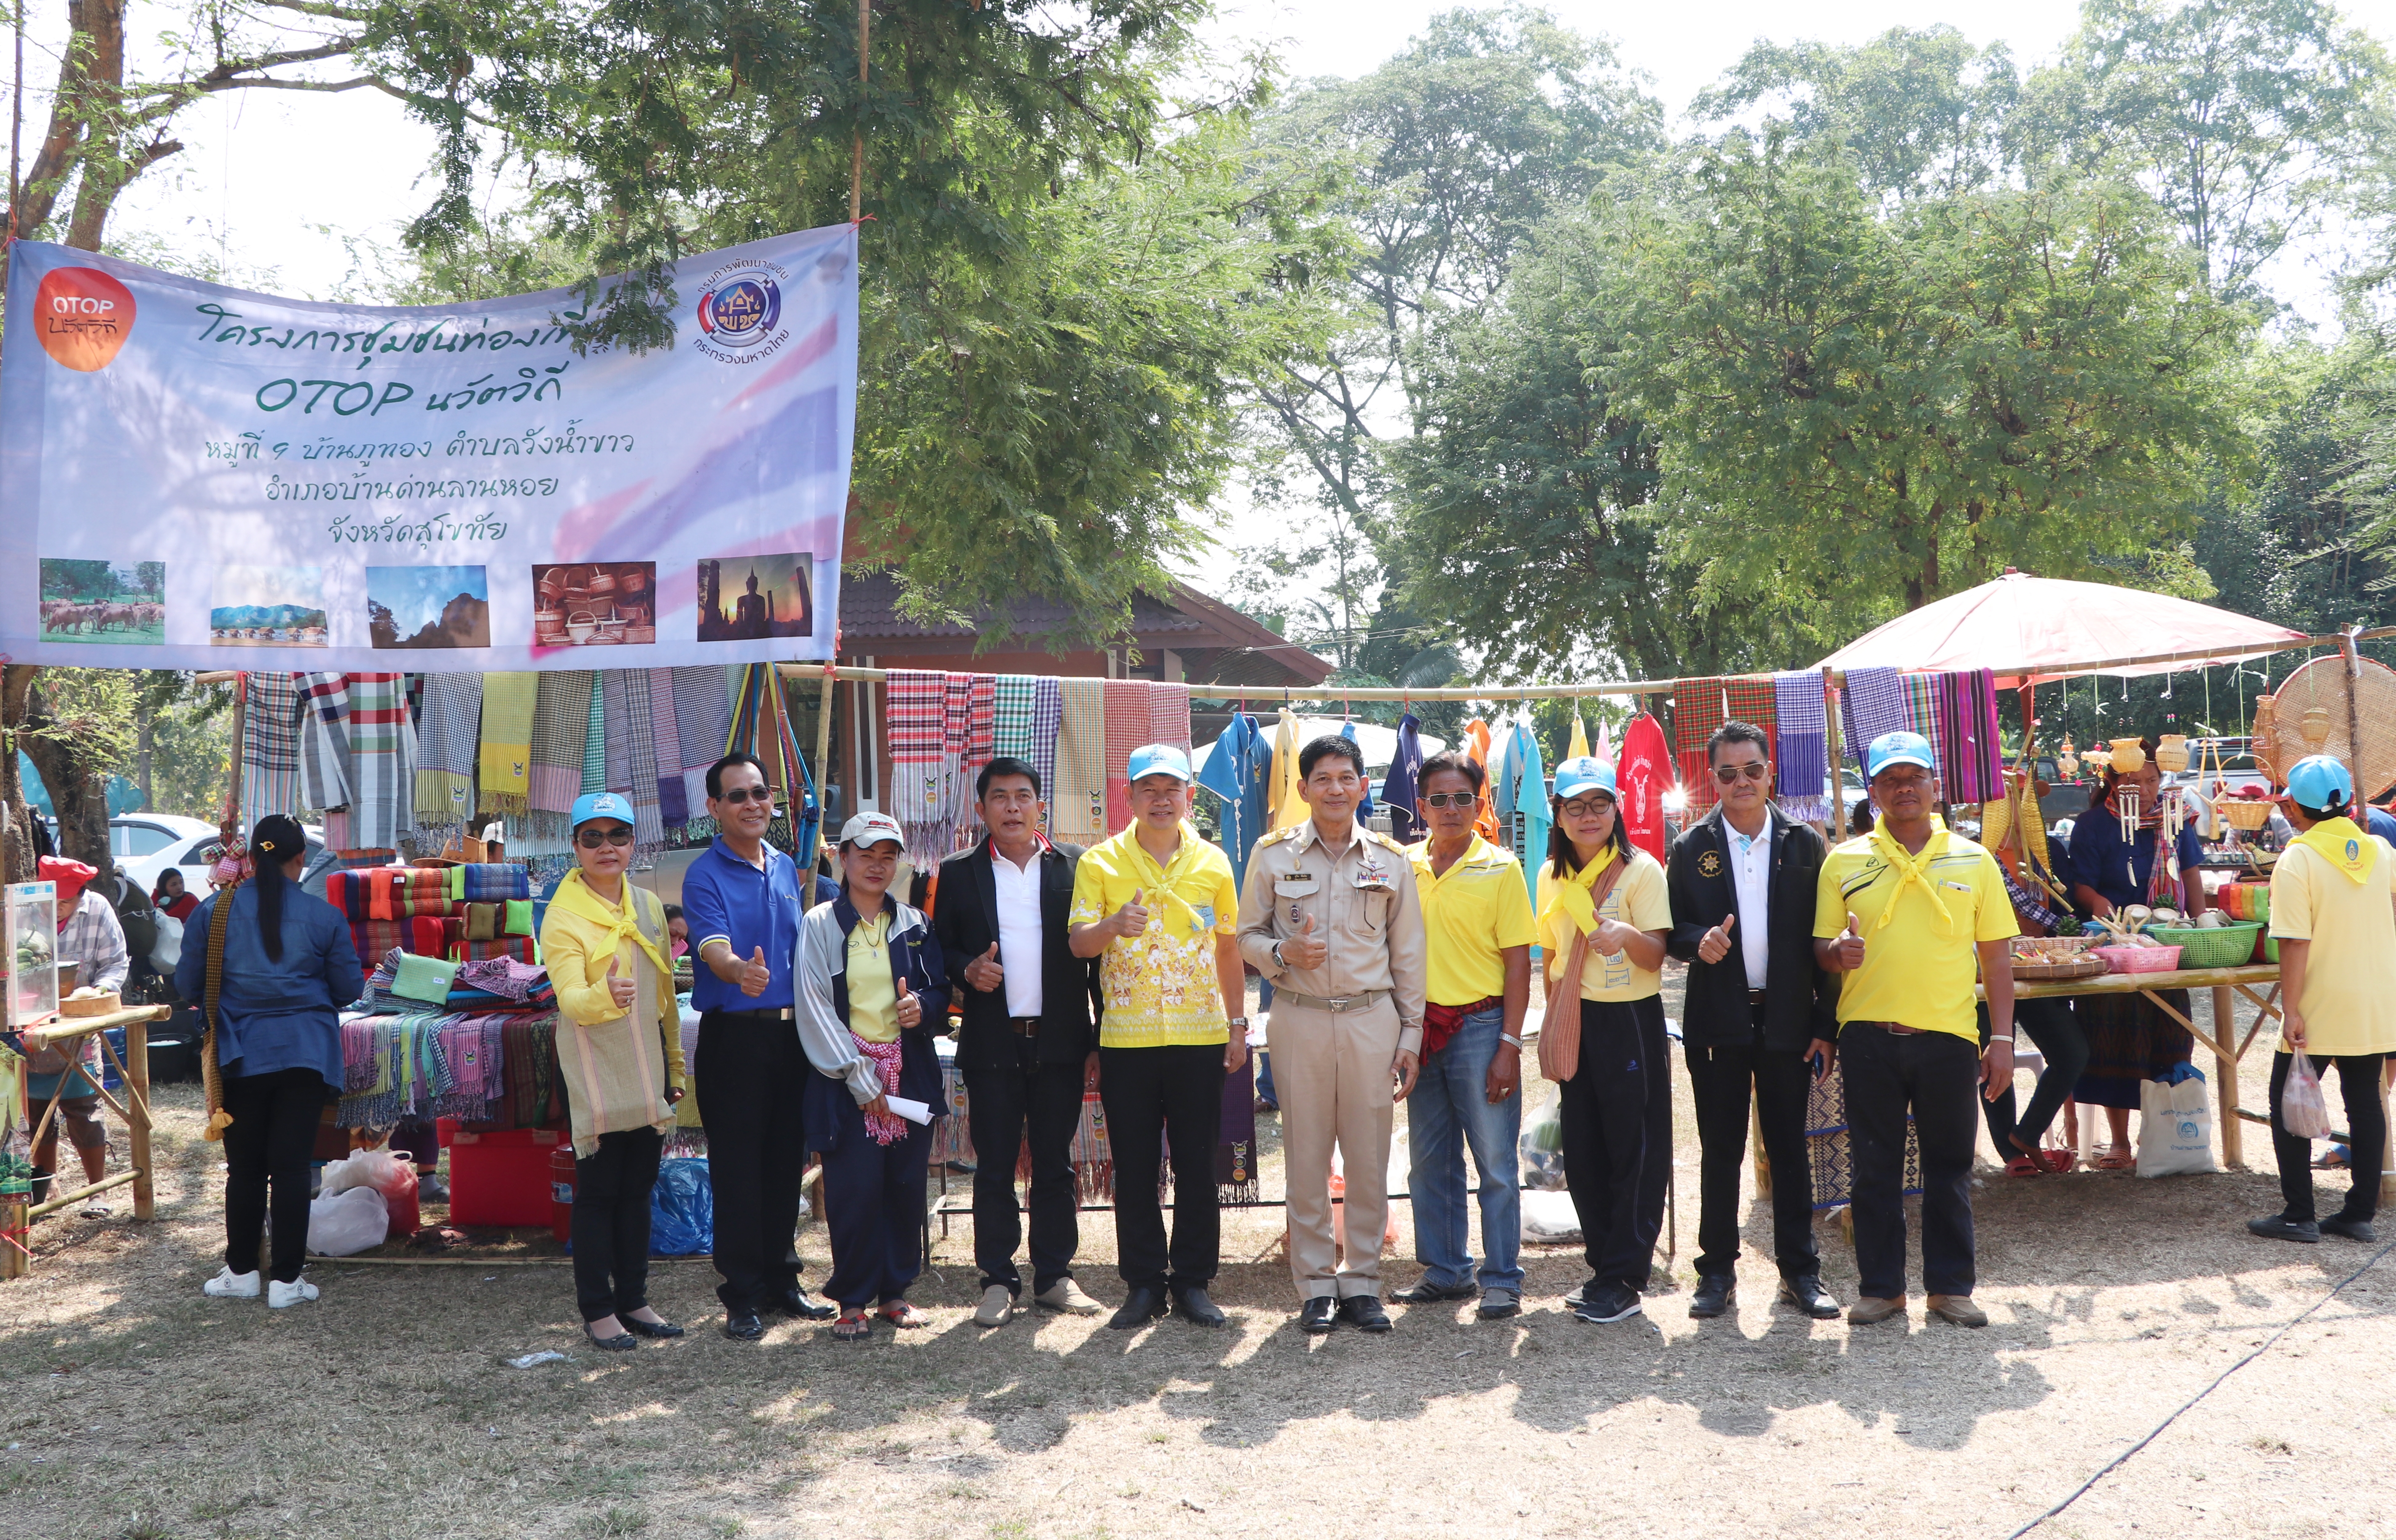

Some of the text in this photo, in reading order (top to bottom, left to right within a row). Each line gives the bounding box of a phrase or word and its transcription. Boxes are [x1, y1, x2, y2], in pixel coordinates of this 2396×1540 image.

[697, 258, 790, 293] กรมการพัฒนาชุมชน
[53, 296, 114, 314] OTOP
[693, 329, 790, 364] กระทรวงมหาดไทย
[256, 360, 570, 416] OTOP นวัตวิถี
[206, 430, 265, 468] หมู่ที่
[303, 437, 432, 467] บ้านภูทอง
[446, 419, 634, 457] ตำบลวังน้ำขาว
[265, 473, 559, 501] อำเภอบ้านด่านลานหอย
[328, 511, 508, 551] จังหวัดสุโขทัย
